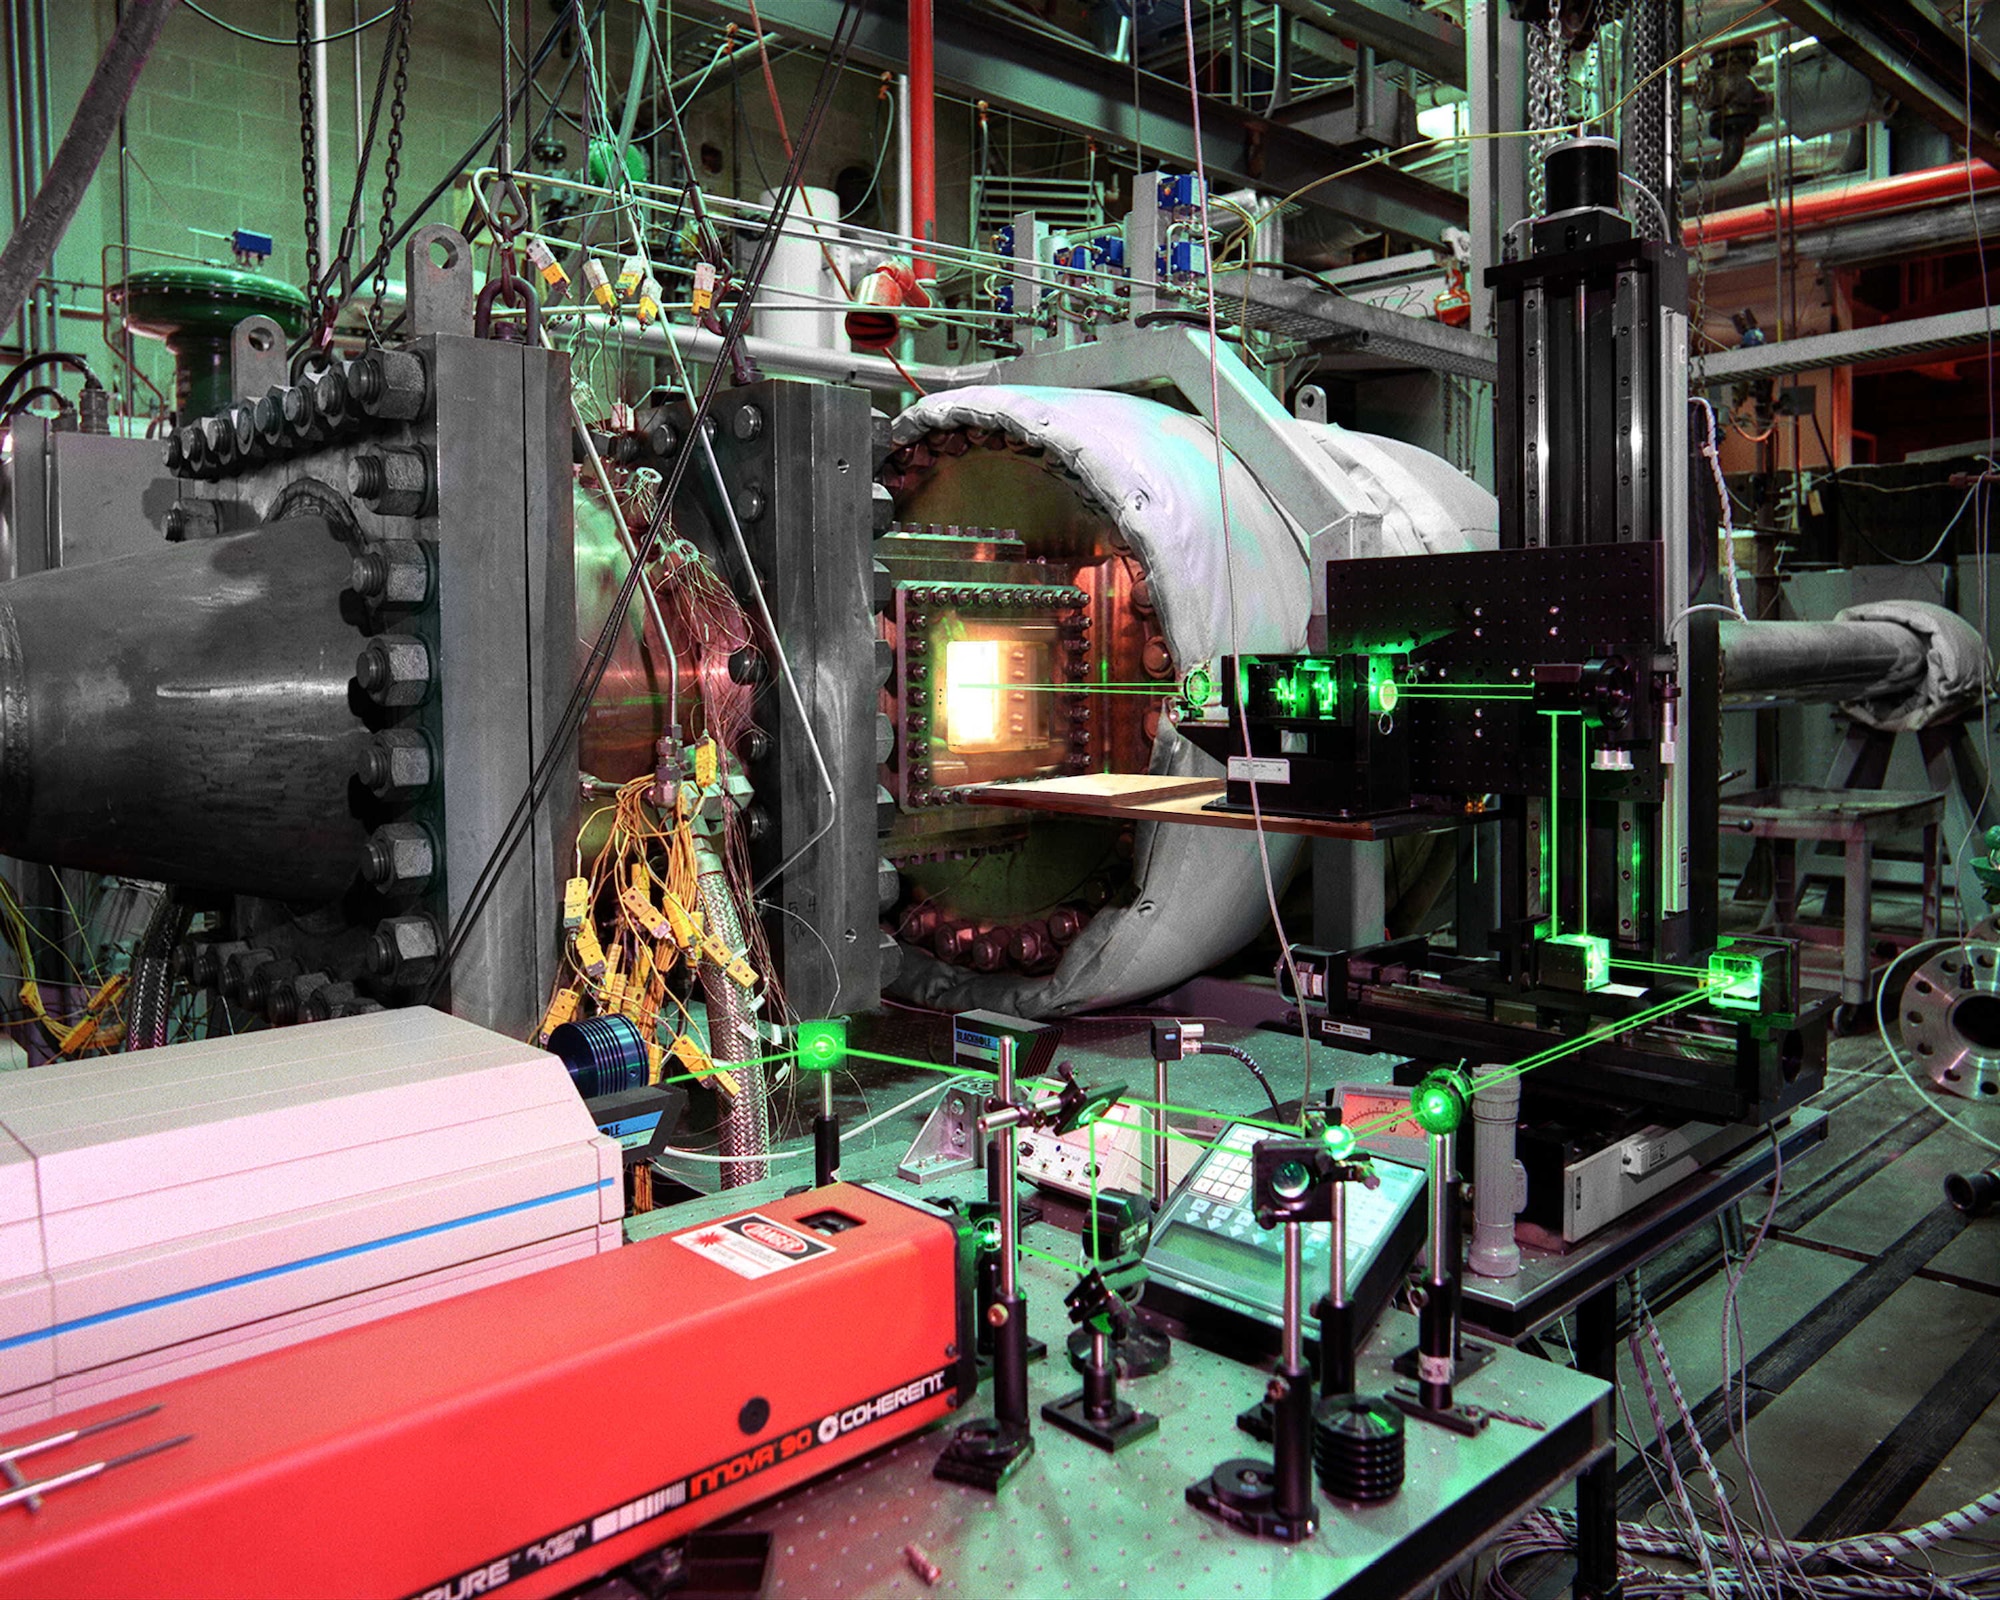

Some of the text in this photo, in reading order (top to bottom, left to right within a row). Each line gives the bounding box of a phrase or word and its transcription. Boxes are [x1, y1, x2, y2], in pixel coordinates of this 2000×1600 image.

[750, 1222, 802, 1252] DANGER
[781, 1428, 813, 1458] 90
[839, 1370, 945, 1433] COHERENT
